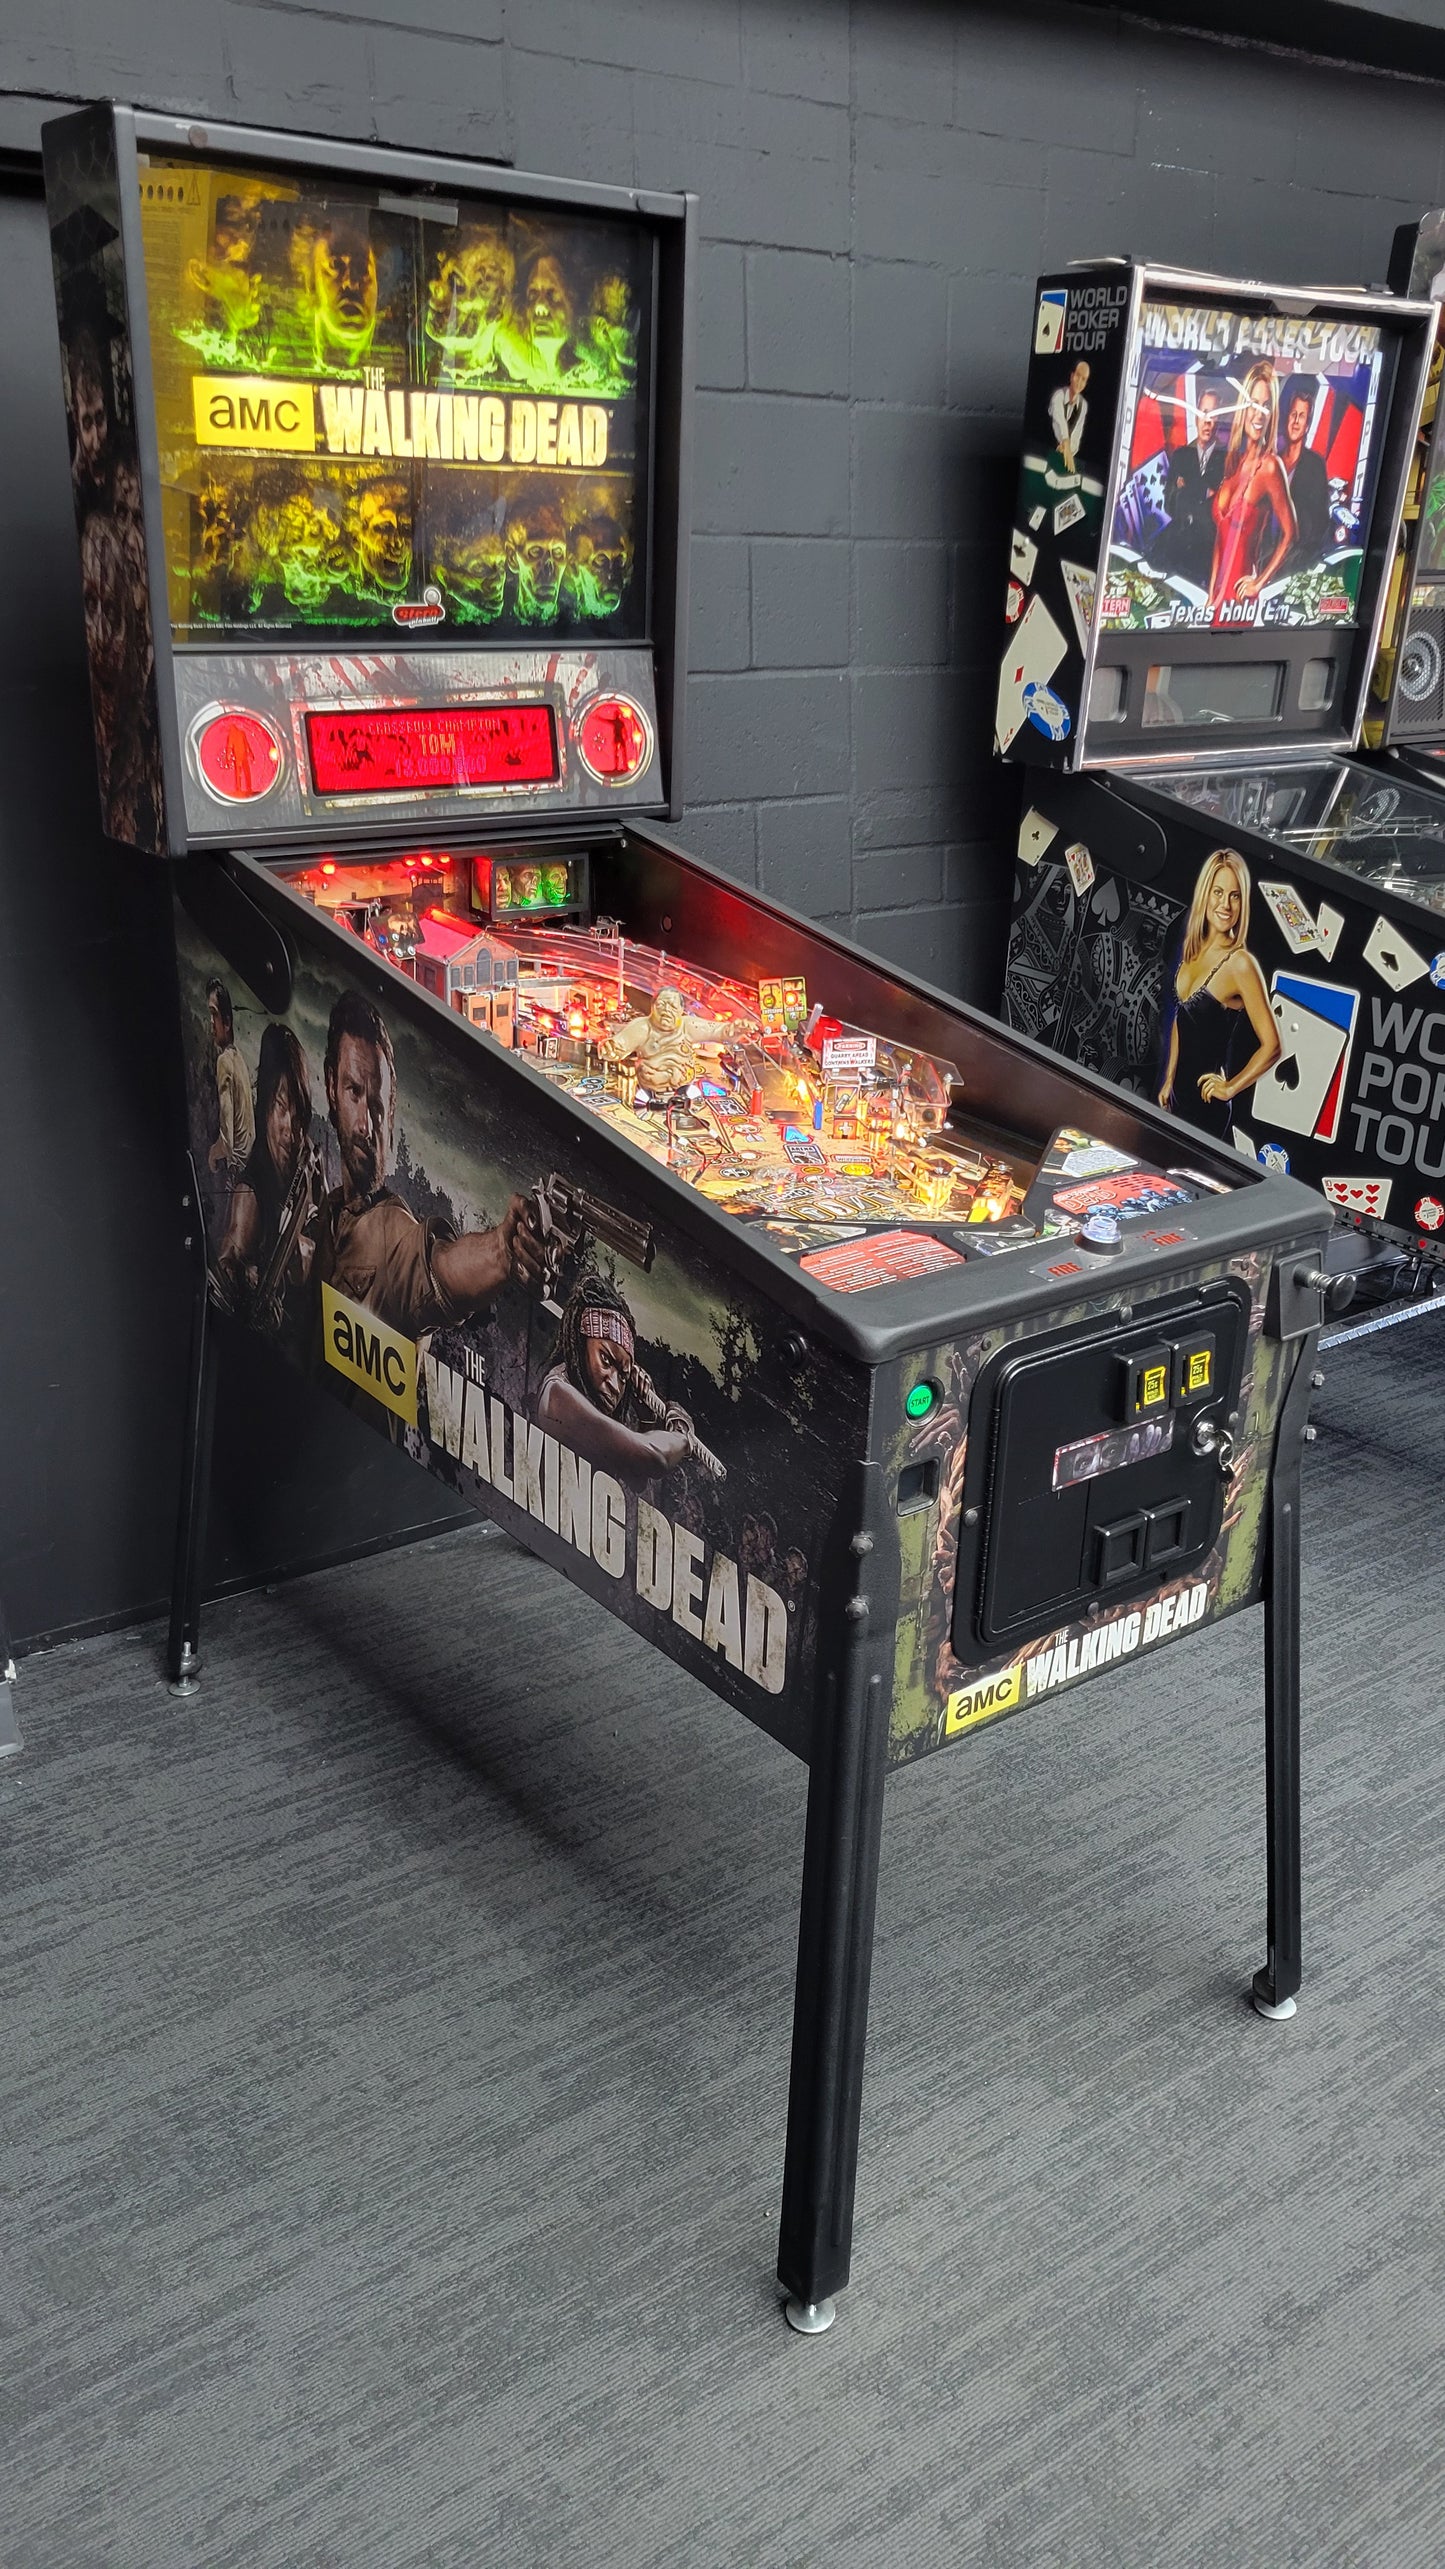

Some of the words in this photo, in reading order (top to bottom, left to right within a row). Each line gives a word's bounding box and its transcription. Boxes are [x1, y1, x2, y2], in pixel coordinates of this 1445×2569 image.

[1070, 286, 1128, 309] WORLD
[1068, 308, 1120, 331] POKER
[1066, 330, 1107, 352] TOUR
[363, 367, 386, 391] THE
[319, 384, 505, 463] WALKING
[511, 399, 608, 467] DEAD
[1102, 599, 1130, 612] TERN
[1168, 599, 1216, 623] Texas
[1219, 599, 1255, 624] Hold
[418, 733, 457, 756] TOM
[1151, 1232, 1187, 1247] FIRE
[1047, 1261, 1084, 1277] FIRE
[463, 1345, 486, 1388] THE
[910, 1395, 930, 1408] START
[422, 1350, 627, 1580] WALKING
[635, 1497, 788, 1695] DEAD
[1025, 1611, 1142, 1698] WALKING
[1142, 1582, 1209, 1645] DEAD
[1055, 1629, 1070, 1647] THE
